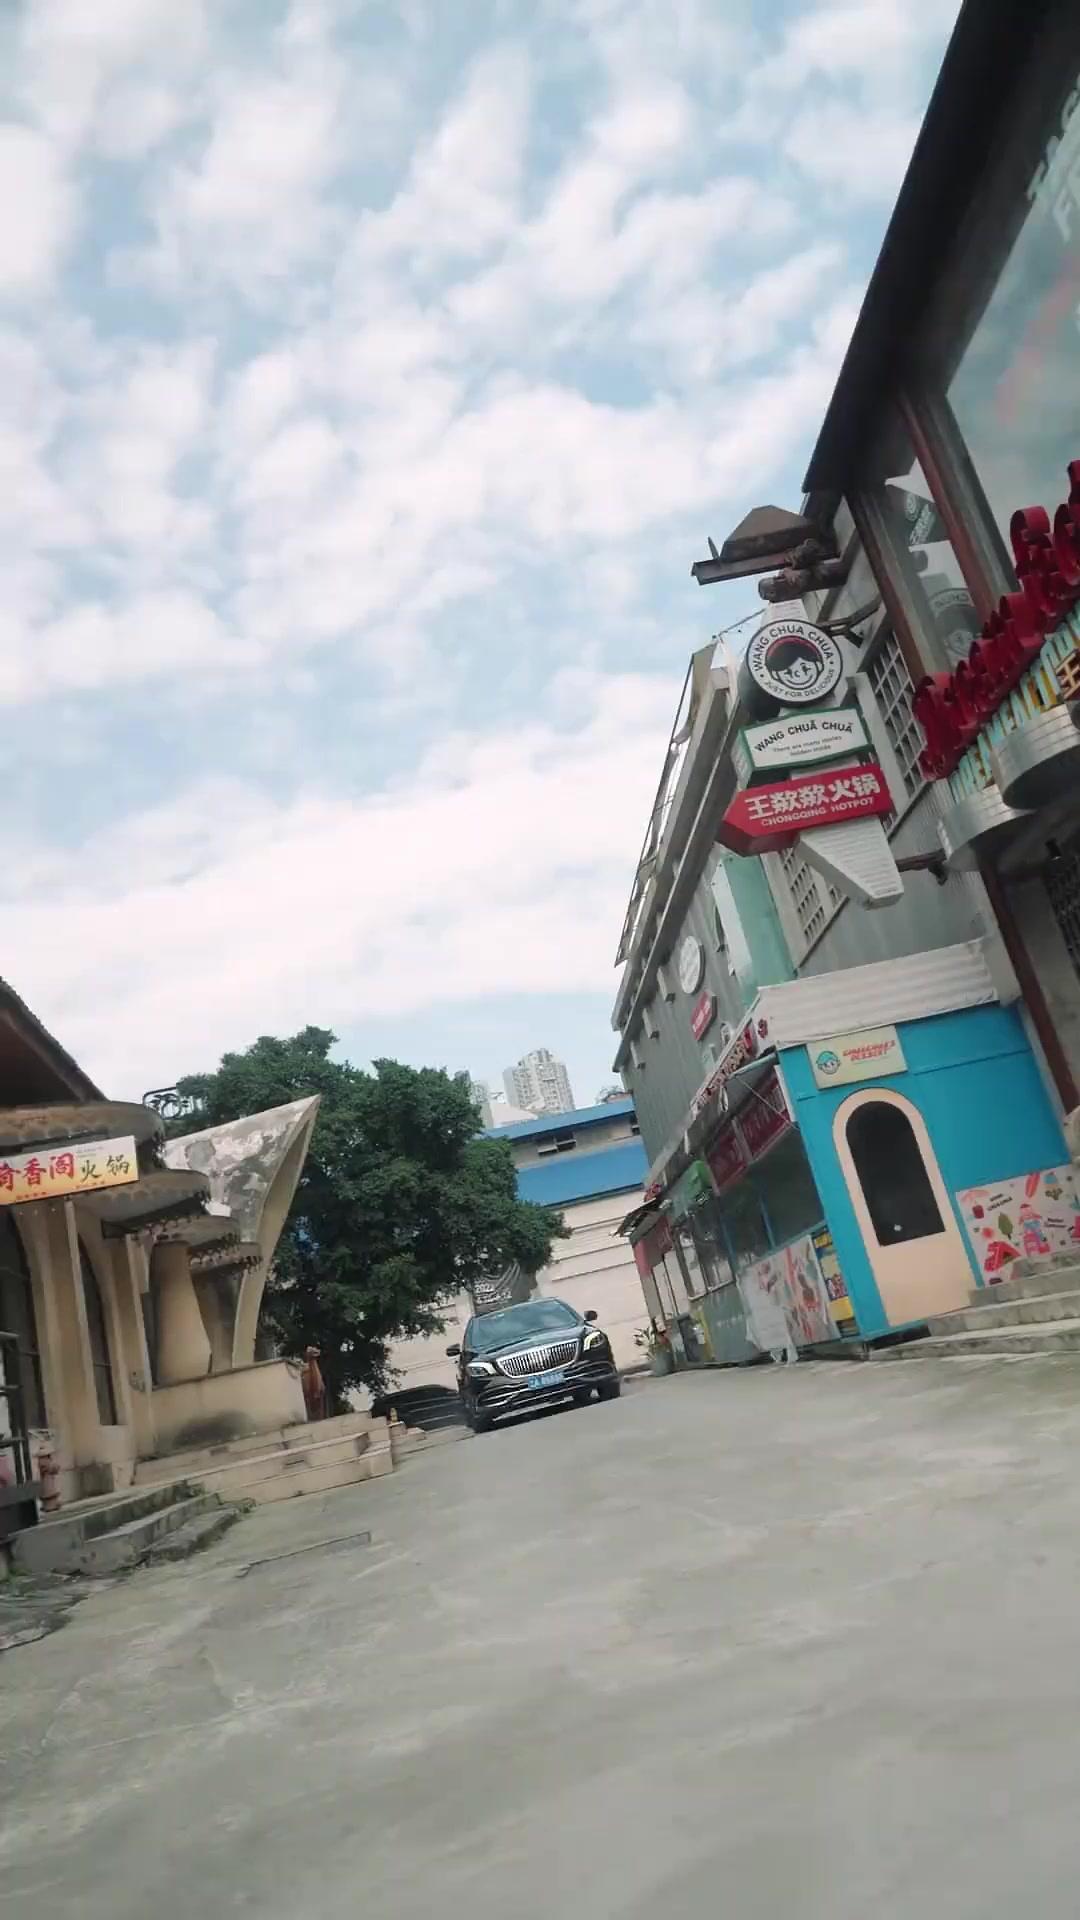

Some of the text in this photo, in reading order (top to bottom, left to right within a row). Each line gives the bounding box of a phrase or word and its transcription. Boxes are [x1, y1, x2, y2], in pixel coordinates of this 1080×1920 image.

[752, 624, 834, 672] WANG CHUA CHUA
[754, 731, 785, 752] WANG
[761, 796, 874, 826] CHONGQING HOTPOT
